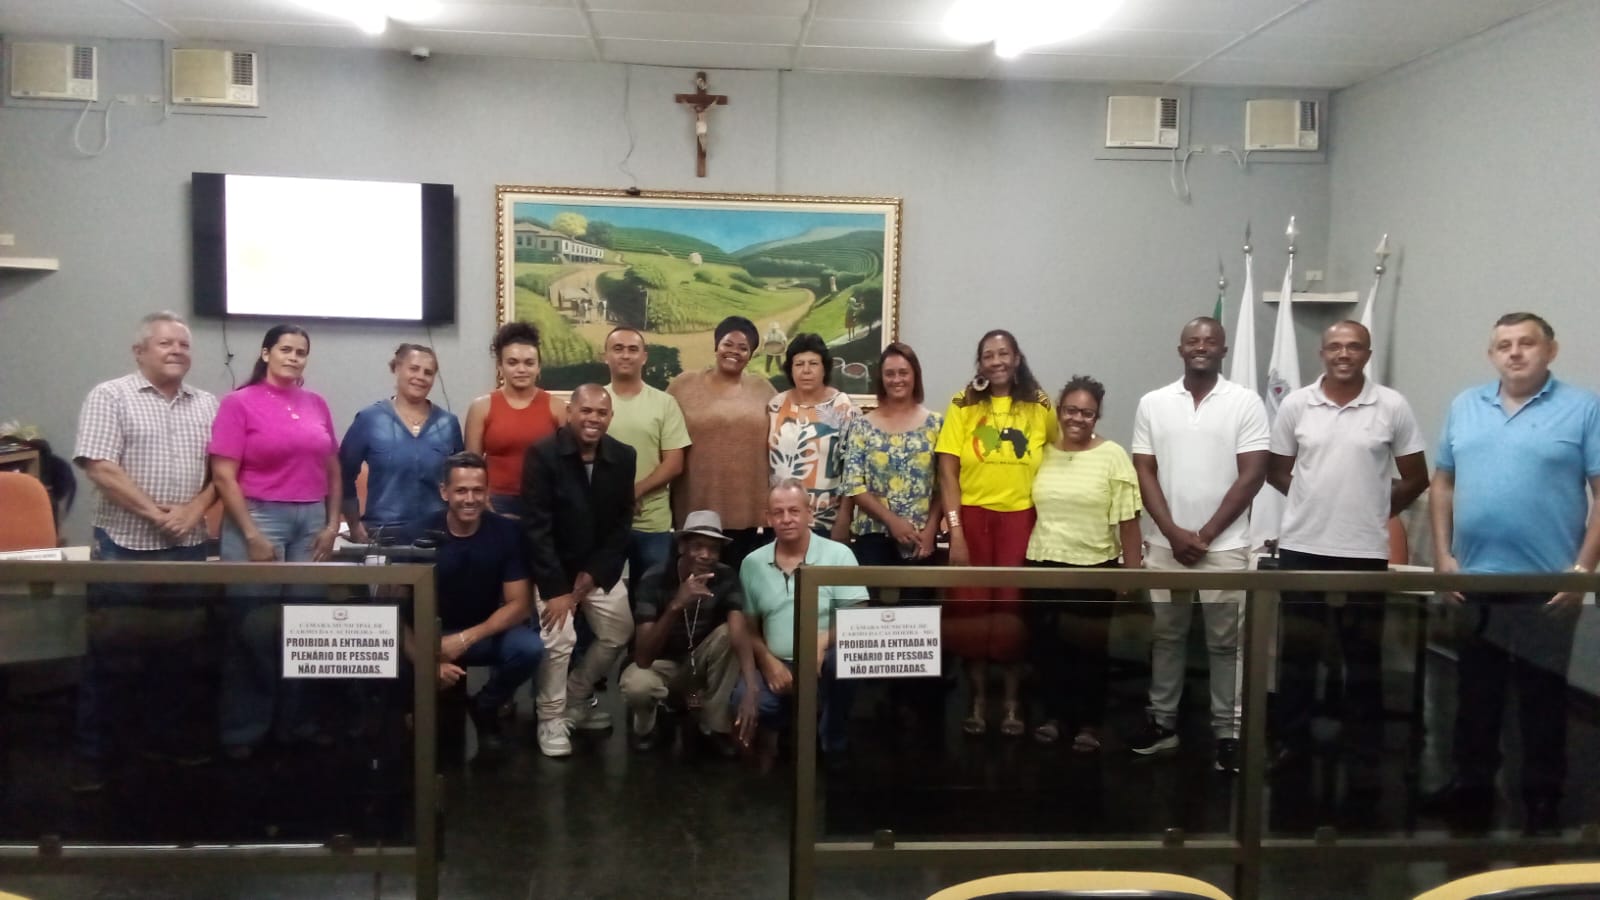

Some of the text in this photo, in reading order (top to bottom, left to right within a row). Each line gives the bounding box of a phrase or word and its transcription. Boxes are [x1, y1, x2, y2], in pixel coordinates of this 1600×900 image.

[286, 637, 394, 648] PROIBIDA A ENTRADA NO
[839, 638, 938, 649] PROIBIDA A ENTRADA NO
[291, 650, 390, 661] PLENÁRIO DE PESSOAS
[843, 651, 934, 662] PLENÁRIO DE PESSOAS
[298, 663, 316, 674] NÃO
[850, 664, 928, 675] NÃO AUTORIZADAS.
